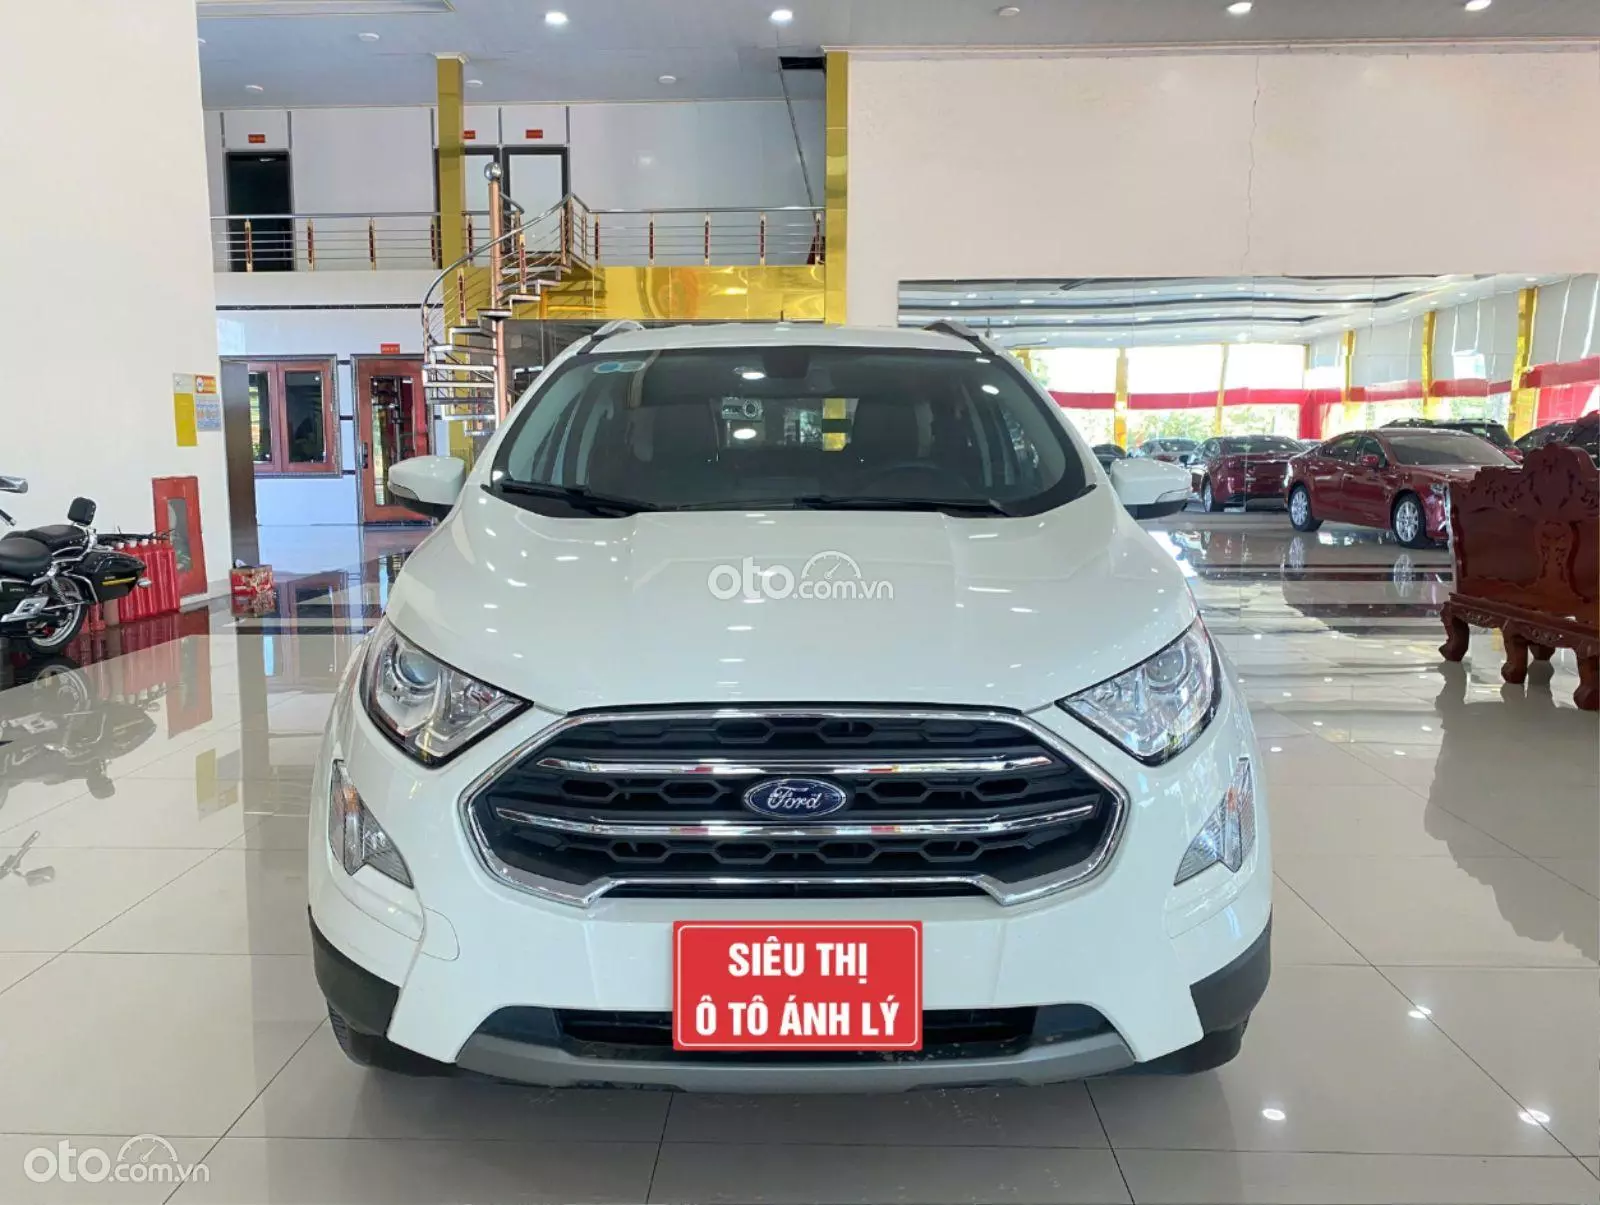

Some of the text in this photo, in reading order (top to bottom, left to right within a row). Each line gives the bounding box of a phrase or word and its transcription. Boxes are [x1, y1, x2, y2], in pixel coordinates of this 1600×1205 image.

[767, 785, 823, 809] Ford
[728, 935, 868, 984] SIÊU THỊ
[695, 994, 900, 1037] Ô TÔ ÁNH LÝ
